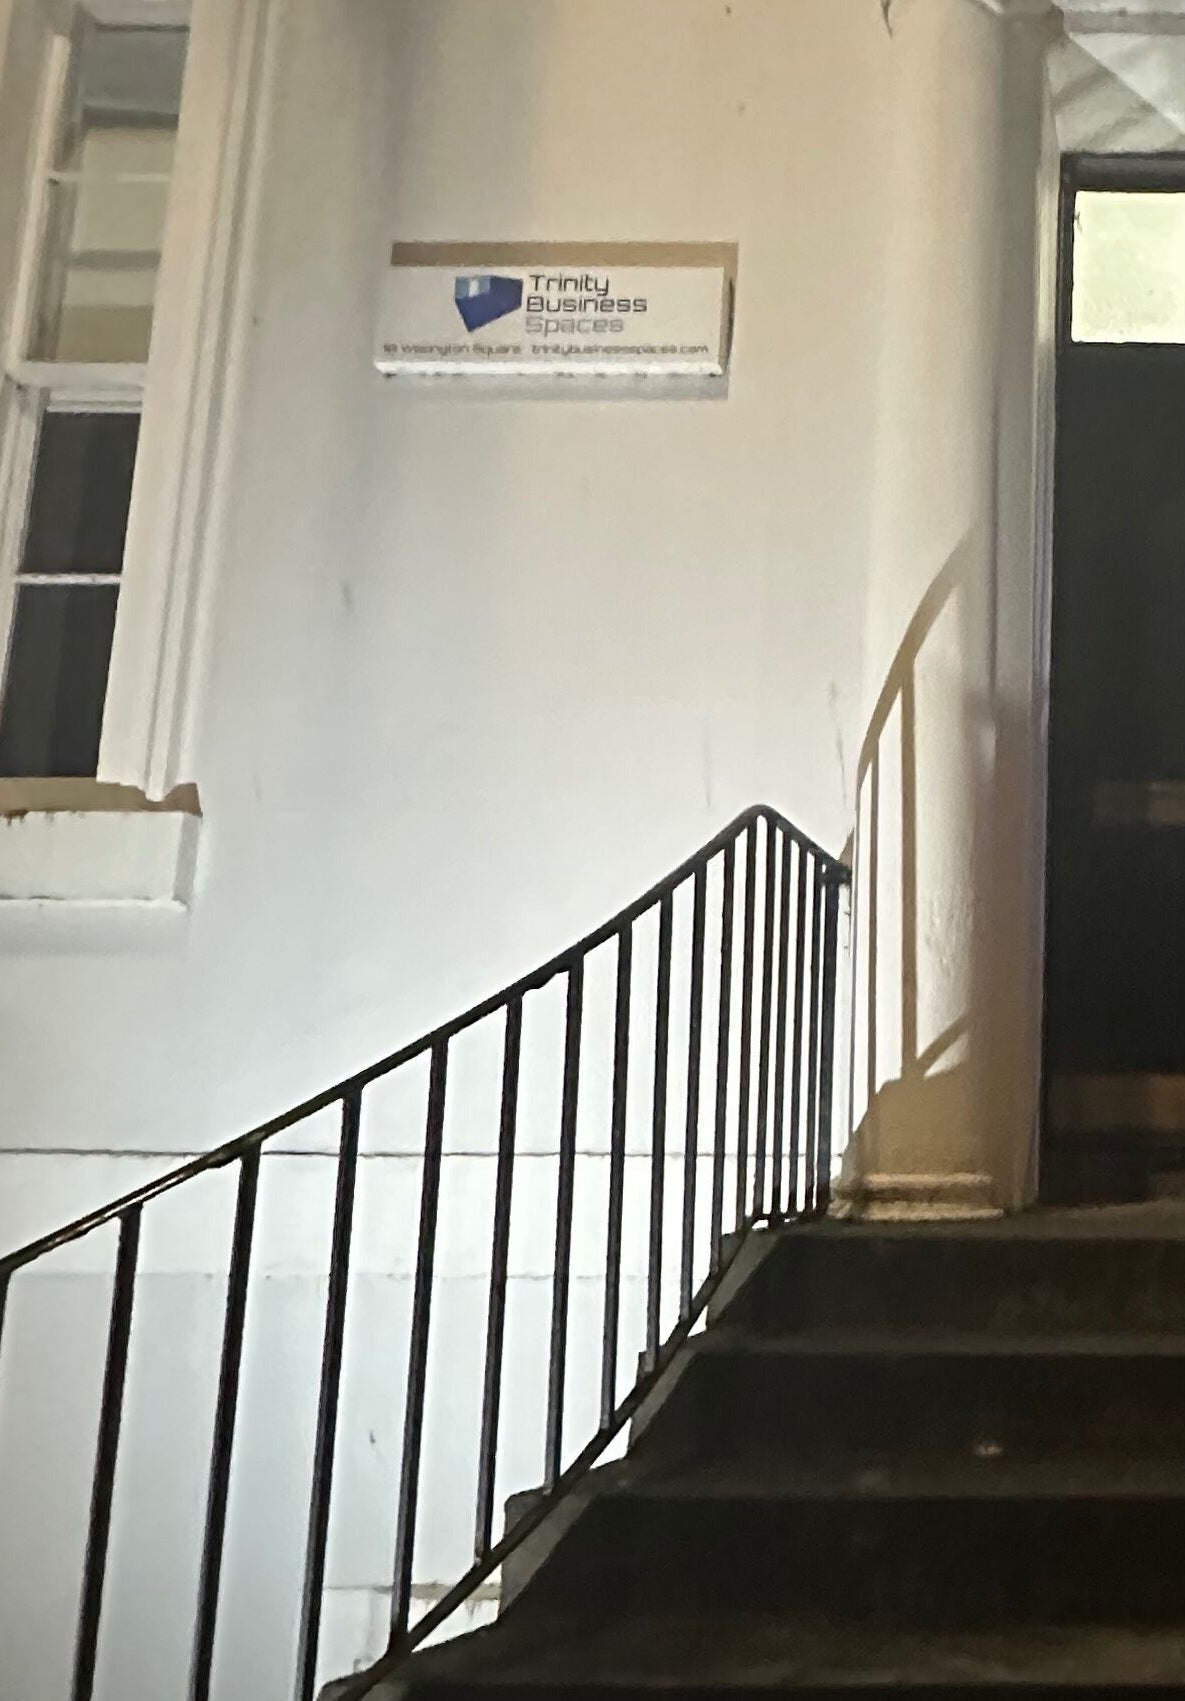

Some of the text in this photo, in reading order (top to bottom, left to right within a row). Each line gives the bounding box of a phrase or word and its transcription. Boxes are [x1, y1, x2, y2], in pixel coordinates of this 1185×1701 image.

[528, 273, 609, 296] Trinity
[526, 296, 648, 312] Business
[525, 316, 624, 338] Spaces
